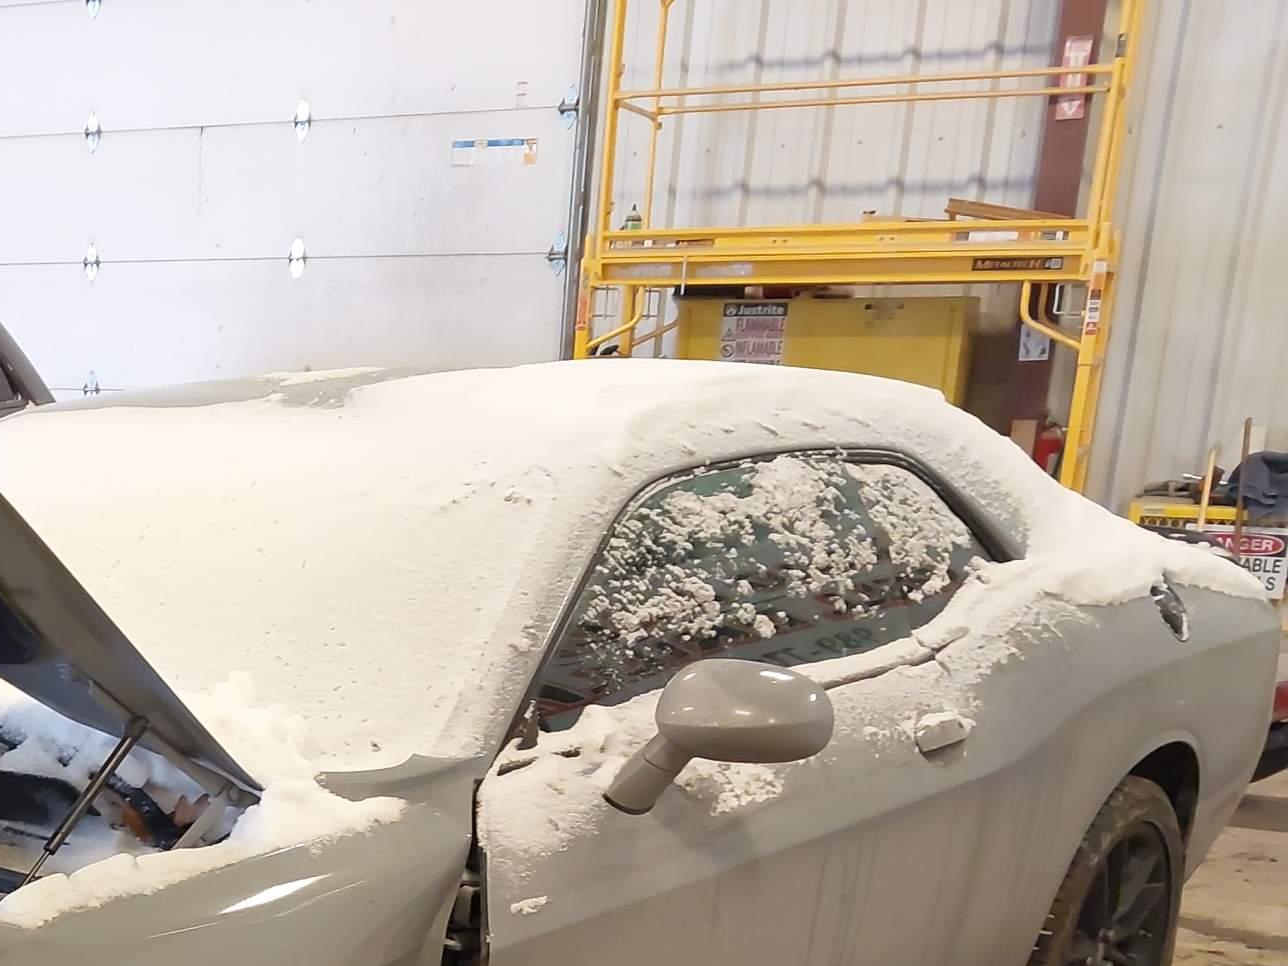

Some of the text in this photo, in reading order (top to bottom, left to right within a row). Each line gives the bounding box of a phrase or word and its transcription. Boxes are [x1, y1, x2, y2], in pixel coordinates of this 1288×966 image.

[737, 304, 785, 315] Justrite
[1215, 536, 1274, 552] NGER
[1242, 557, 1283, 574] ABLE
